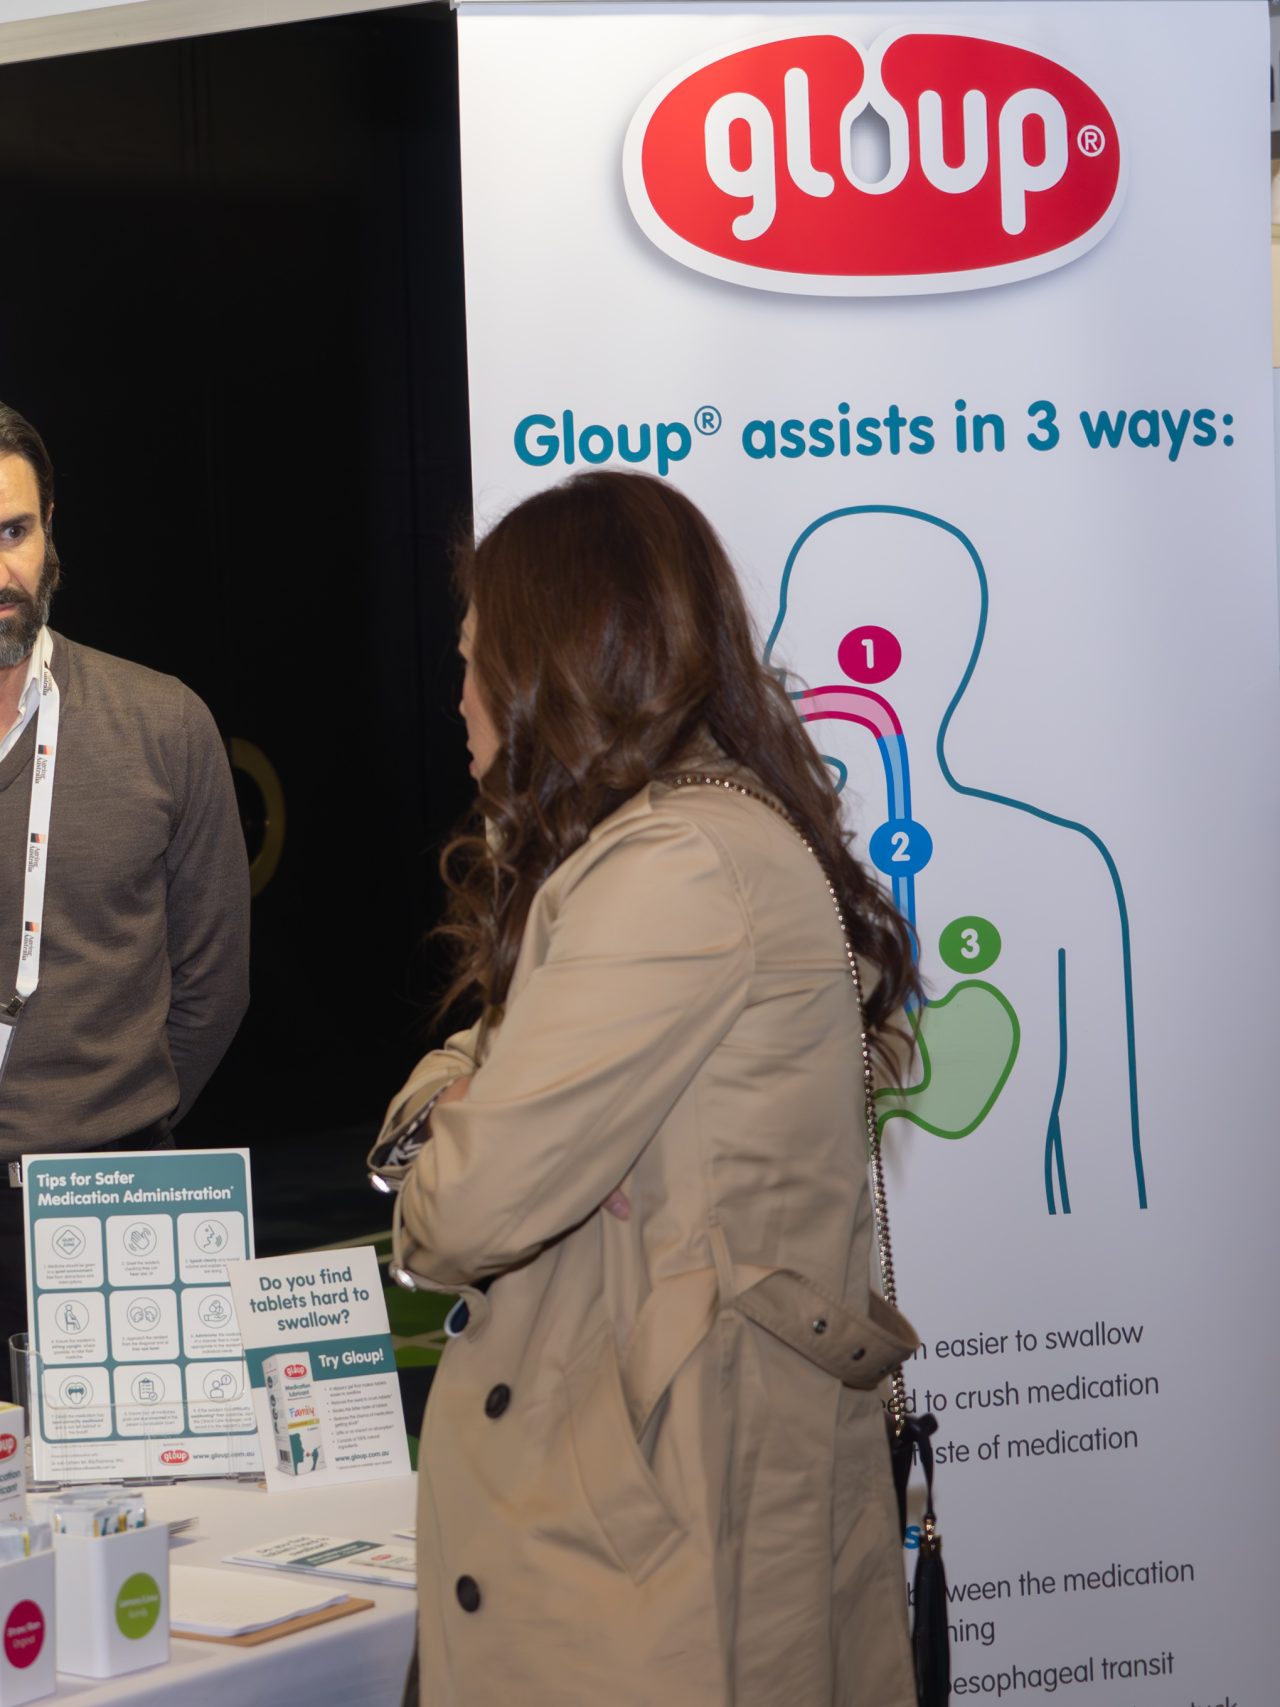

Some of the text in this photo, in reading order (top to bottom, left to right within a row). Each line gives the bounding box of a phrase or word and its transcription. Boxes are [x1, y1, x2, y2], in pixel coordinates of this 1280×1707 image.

[742, 402, 935, 460] assists
[955, 399, 1005, 455] in
[1026, 400, 1060, 452] 3
[1080, 406, 1235, 463] ways:
[861, 638, 874, 669] 1
[891, 831, 910, 862] 2
[960, 928, 980, 959] 3
[37, 1171, 135, 1190] Tips for Safer
[37, 1190, 120, 1206] Medication
[259, 1266, 352, 1292] Do you find
[250, 1287, 370, 1313] tablets hard to
[277, 1309, 350, 1331] swallow?
[935, 1332, 1009, 1358] easier
[1016, 1330, 1037, 1352] to
[1045, 1321, 1144, 1350] swallow
[318, 1348, 384, 1370] Try Gloup!
[924, 1390, 948, 1413] to
[955, 1381, 1019, 1410] crush
[1028, 1374, 1159, 1404] medication
[977, 1435, 1001, 1461] of
[1008, 1427, 1138, 1459] medication
[1019, 1571, 1056, 1596] the
[1063, 1560, 1195, 1593] medication
[949, 1651, 1174, 1698] esophageal transit
